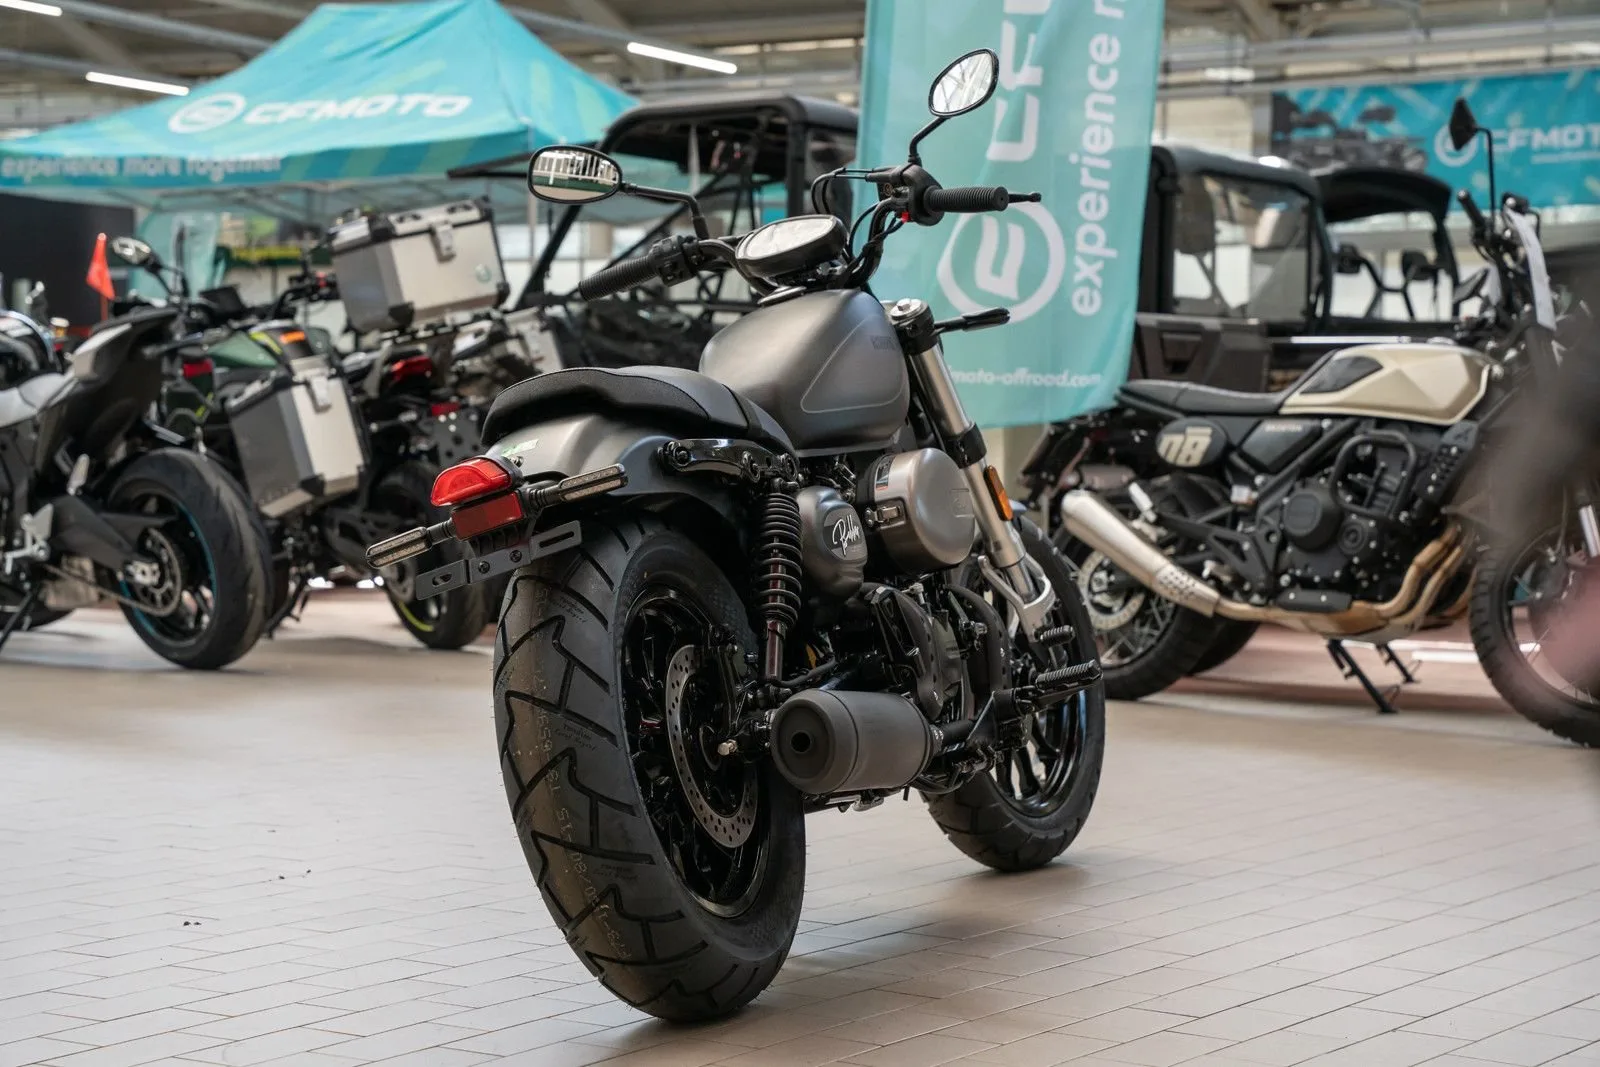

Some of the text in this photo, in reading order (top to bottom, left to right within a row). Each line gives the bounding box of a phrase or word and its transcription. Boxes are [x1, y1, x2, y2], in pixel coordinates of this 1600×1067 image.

[242, 94, 471, 124] CFMOTO
[986, 0, 1050, 163] CF
[1069, 32, 1122, 317] experience
